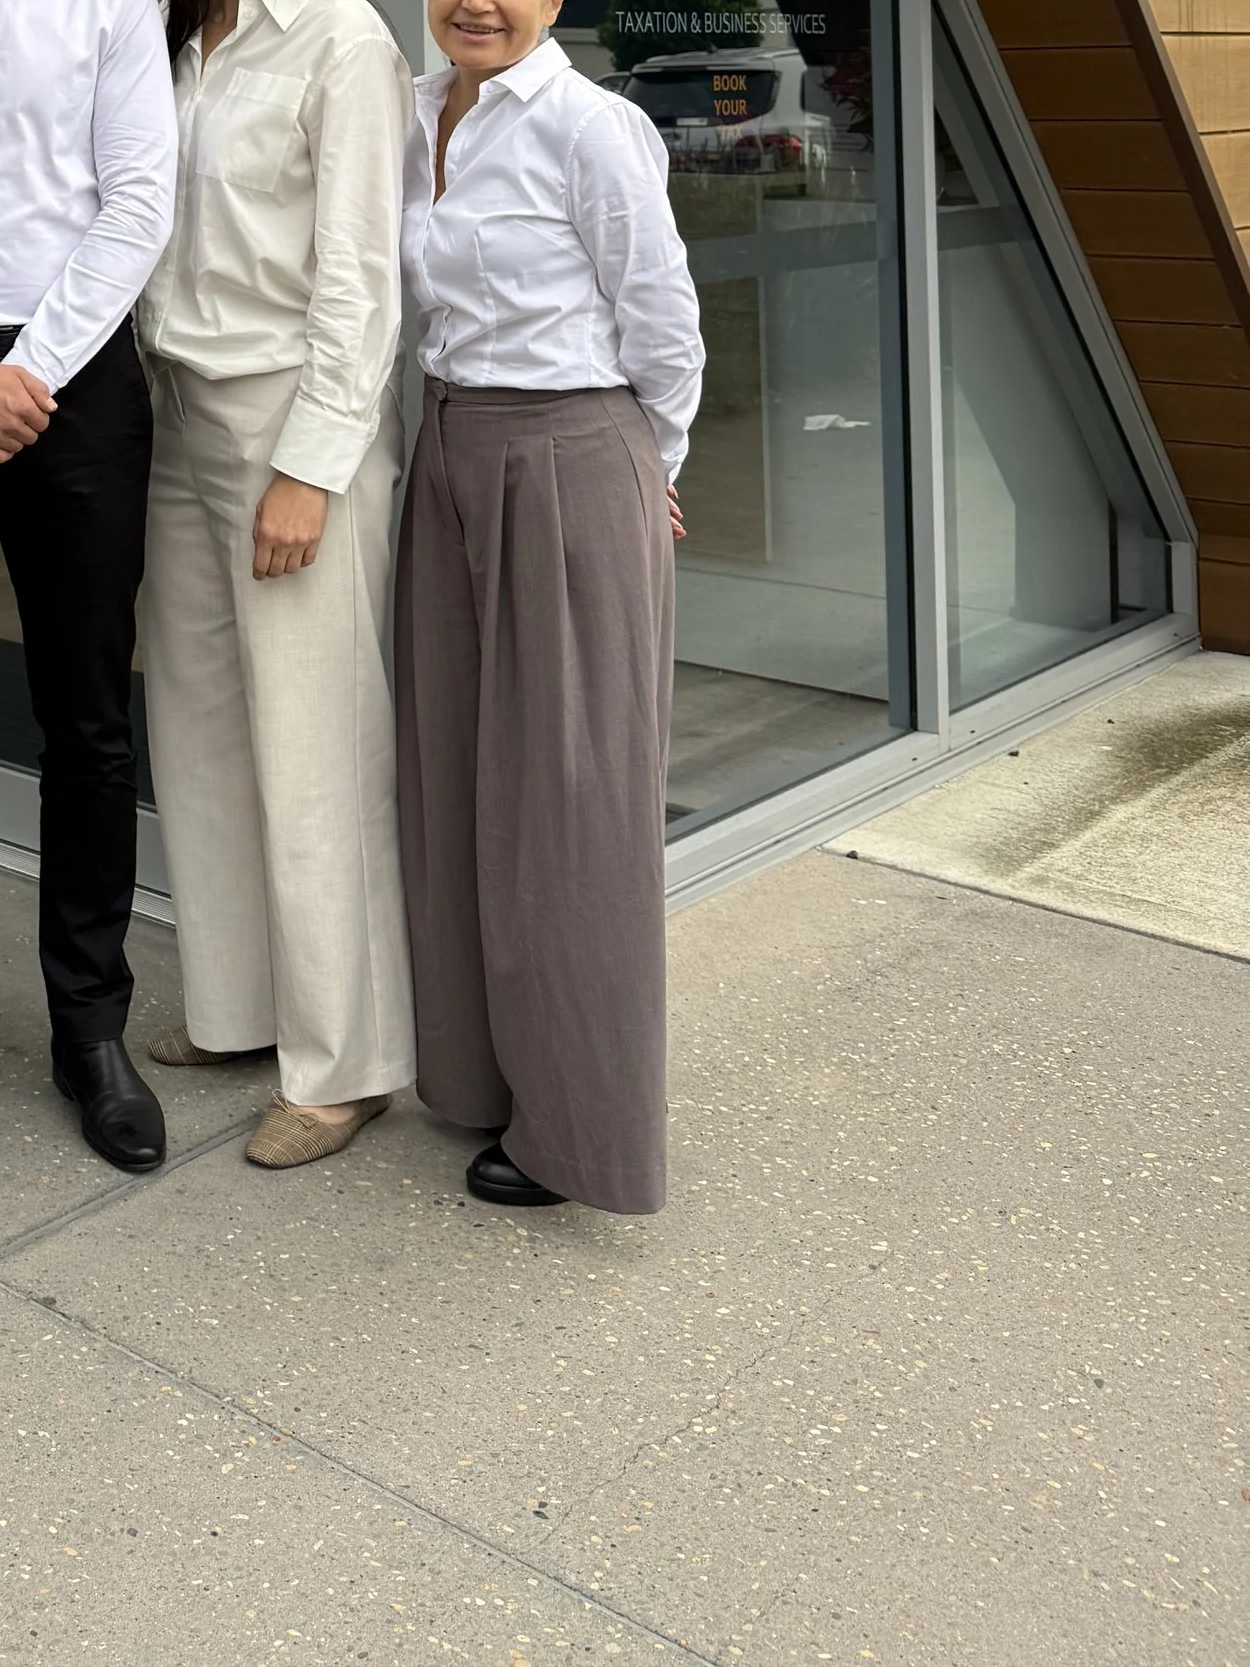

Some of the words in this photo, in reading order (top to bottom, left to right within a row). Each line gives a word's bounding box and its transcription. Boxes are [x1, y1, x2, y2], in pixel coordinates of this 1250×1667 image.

[615, 11, 688, 34] TAXATION
[690, 11, 702, 34] &
[704, 12, 768, 35] BUSINESS
[769, 13, 826, 35] SERVICES
[713, 74, 748, 92] BOOK
[713, 99, 748, 117] YOUR
